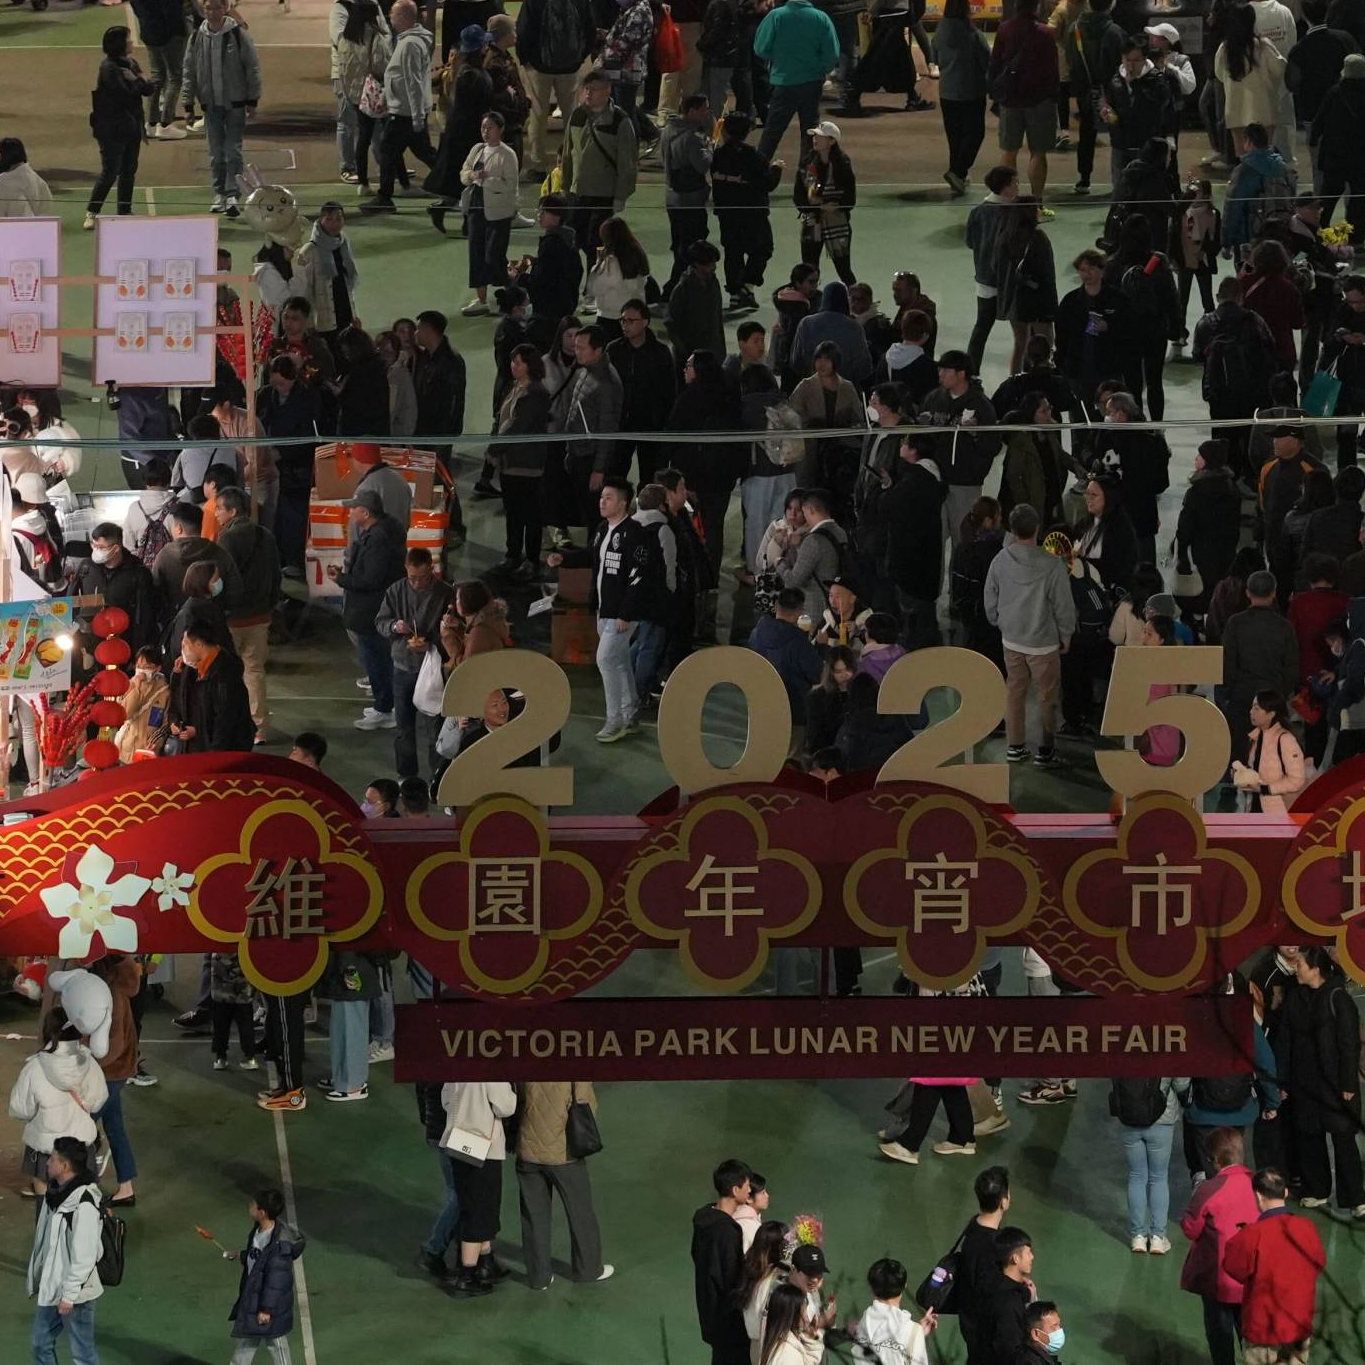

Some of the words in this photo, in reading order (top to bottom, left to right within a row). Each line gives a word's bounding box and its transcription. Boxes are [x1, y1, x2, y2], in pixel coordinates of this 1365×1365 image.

[438, 645, 1232, 806] 2025
[441, 1029, 623, 1058] VICTORIA
[635, 1027, 739, 1056] PARK
[749, 1026, 878, 1055] LUNAR
[891, 1025, 976, 1053] NEW
[987, 1025, 1089, 1053] YEAR
[1101, 1024, 1187, 1053] FAIR
